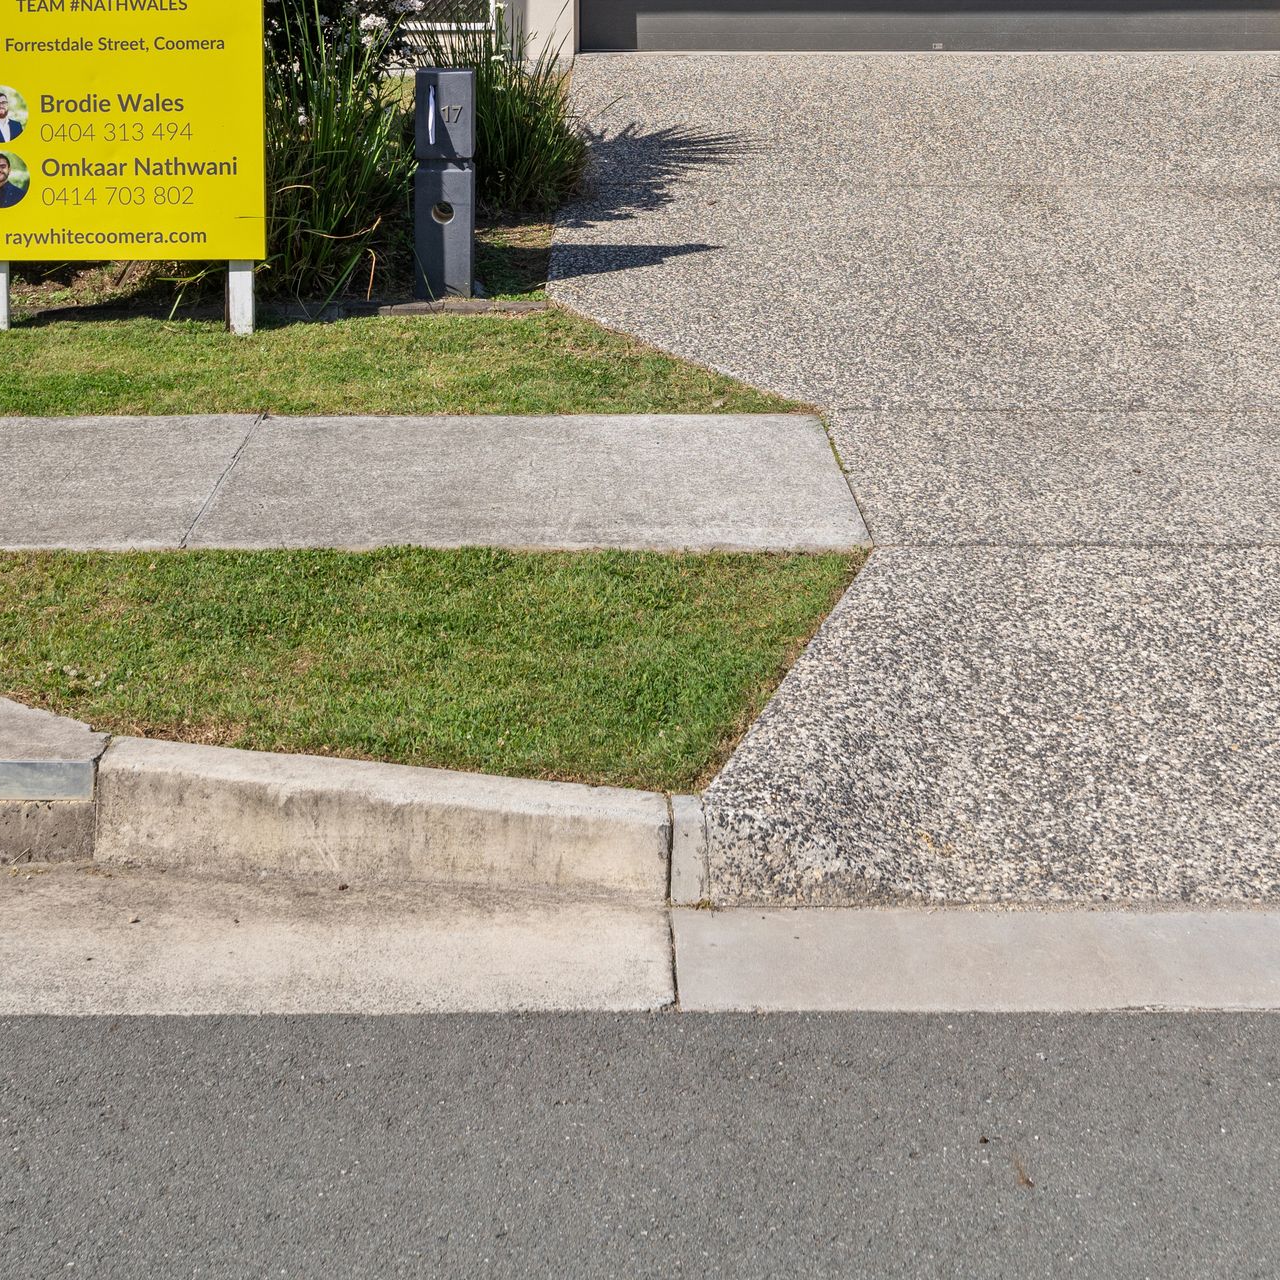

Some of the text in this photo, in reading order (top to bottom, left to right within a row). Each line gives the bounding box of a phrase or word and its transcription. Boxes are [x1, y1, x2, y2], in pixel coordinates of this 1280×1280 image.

[5, 36, 94, 52] Forrestdale
[97, 36, 150, 53] Street,
[153, 36, 225, 51] Coomera
[40, 92, 185, 114] Brodie Wales
[441, 105, 463, 123] 17
[40, 122, 193, 143] 0404 313 494
[41, 156, 238, 177] Omkaar Nathwani
[41, 185, 194, 207] 0414 703 802
[5, 228, 207, 248] raywhitecoomera.com
